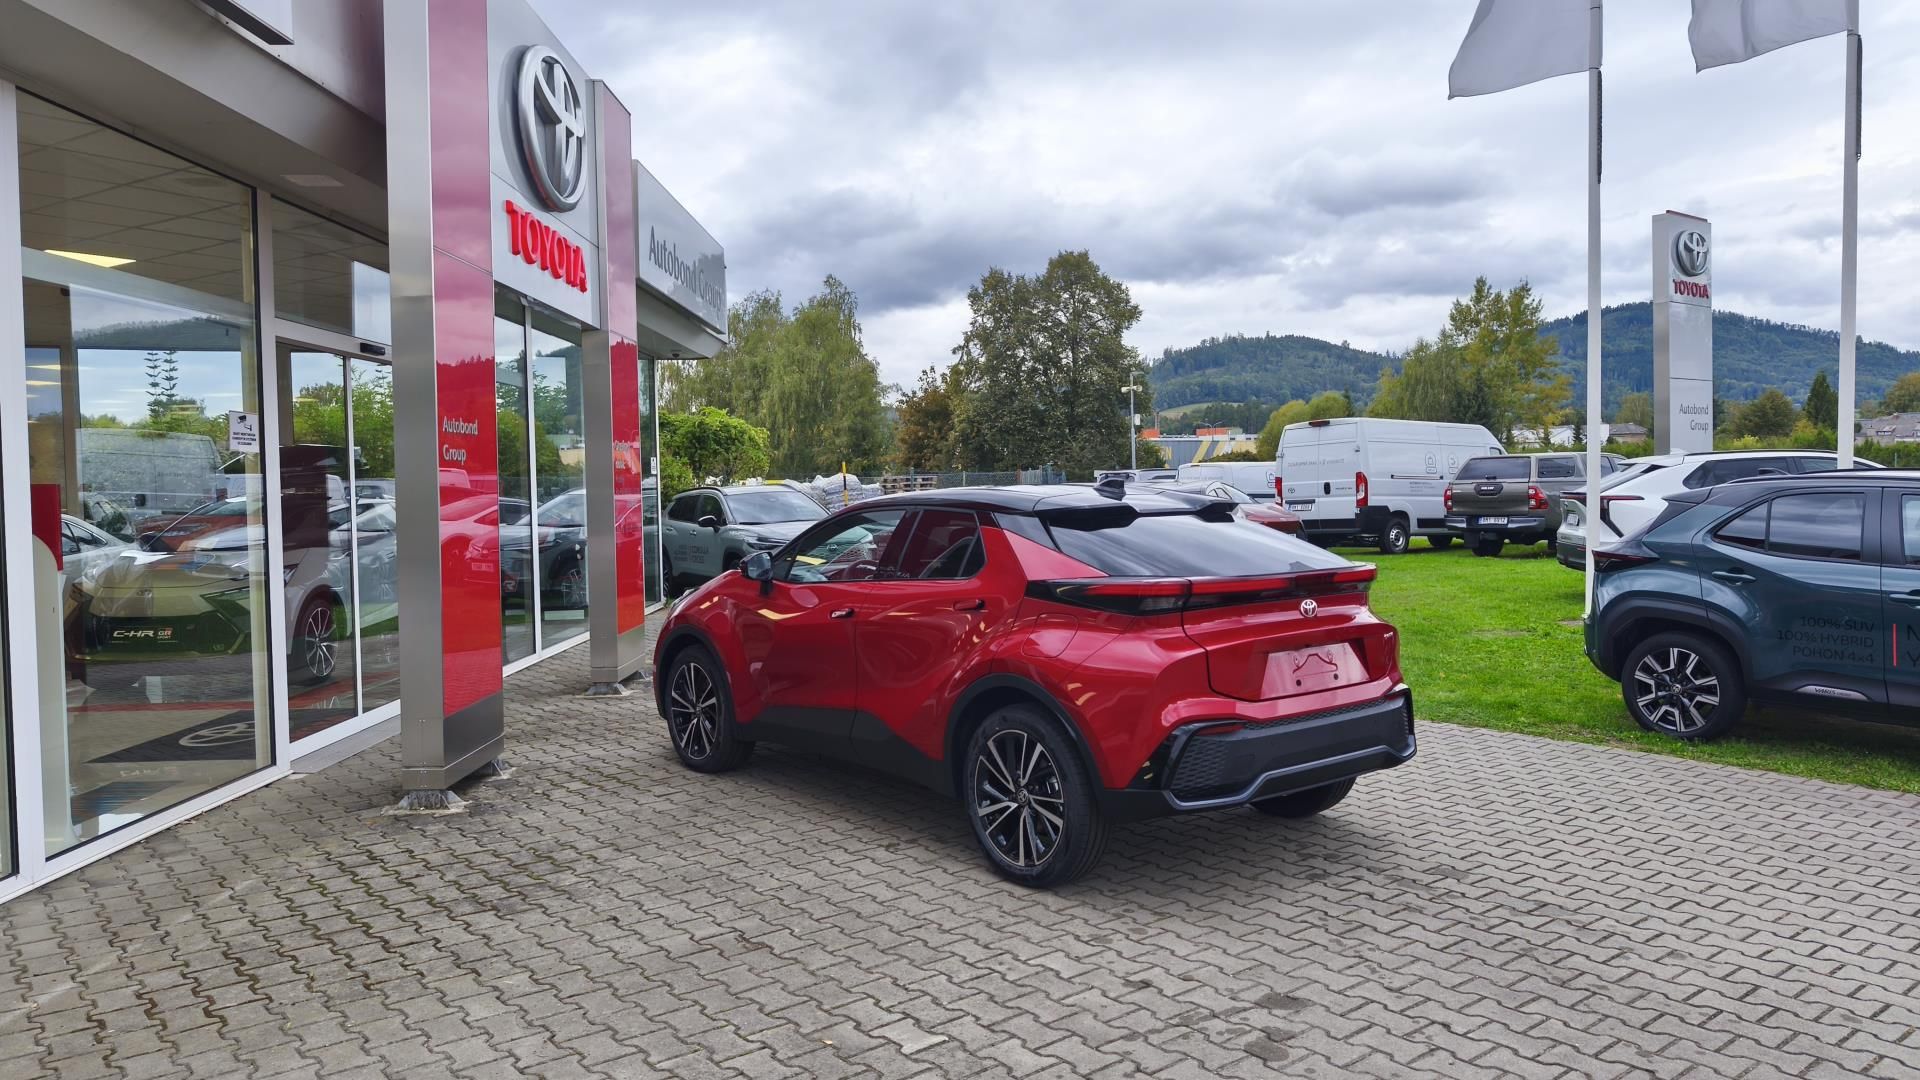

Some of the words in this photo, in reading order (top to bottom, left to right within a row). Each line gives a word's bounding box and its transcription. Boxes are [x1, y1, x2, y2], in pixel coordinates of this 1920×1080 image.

[505, 199, 588, 293] TOYOTA
[649, 225, 697, 295] Autobond
[698, 268, 722, 318] Group
[1673, 279, 1709, 299] TOYOTA
[1679, 403, 1709, 416] Autobond
[443, 415, 478, 435] Autobond
[1690, 419, 1709, 435] Group
[443, 444, 466, 466] Group
[1800, 616, 1841, 629] 100%
[1844, 619, 1875, 632] SUV
[112, 630, 154, 638] C-HR
[1776, 629, 1817, 643] 100%
[1820, 633, 1875, 648] HYBRID
[1792, 645, 1844, 661] POHON
[1847, 652, 1874, 664] 4x4
